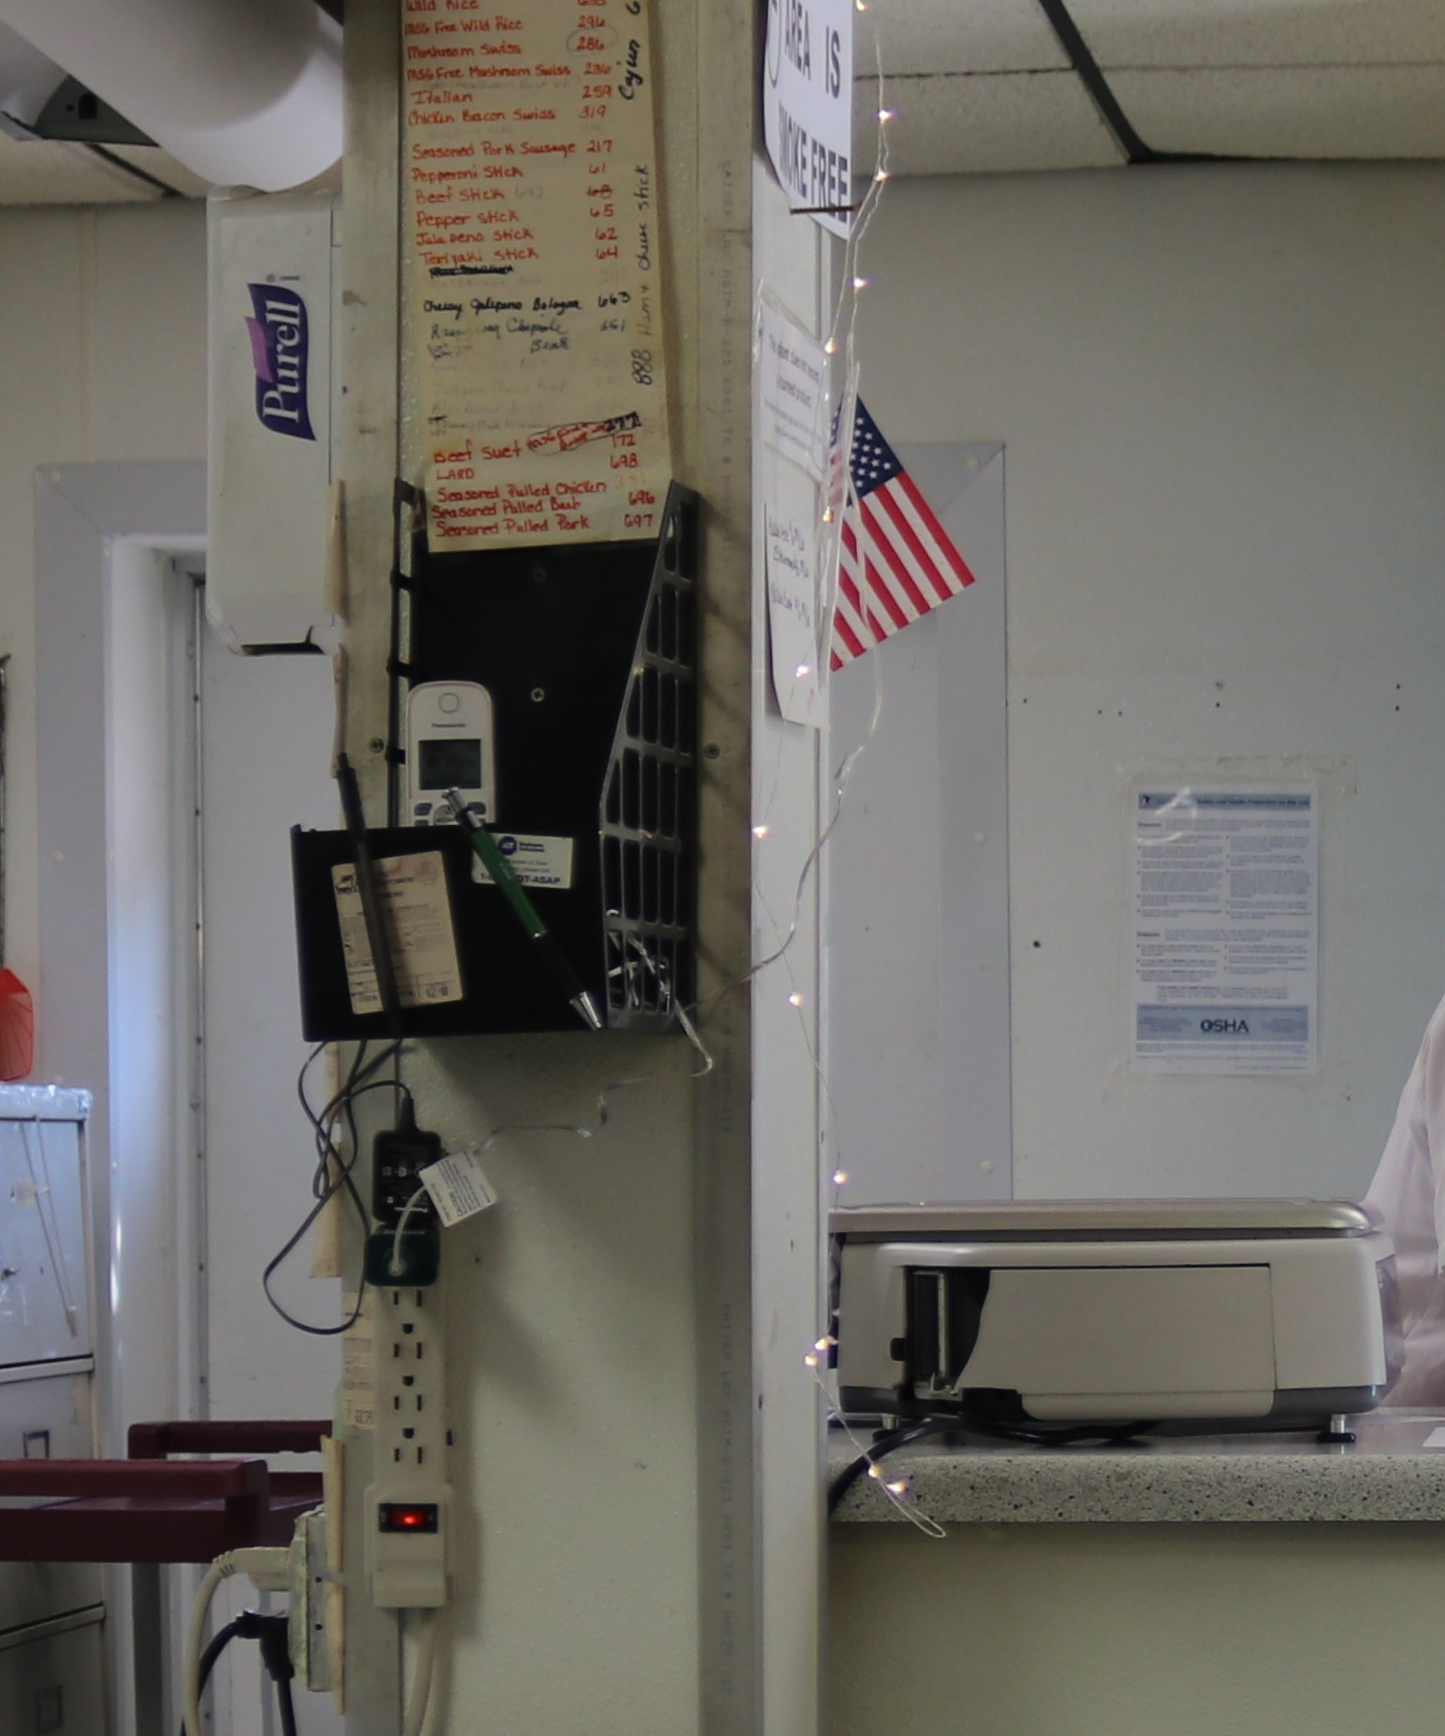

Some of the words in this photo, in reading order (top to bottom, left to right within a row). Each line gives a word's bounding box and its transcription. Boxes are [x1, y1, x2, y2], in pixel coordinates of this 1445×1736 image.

[461, 16, 491, 31] Wild
[495, 15, 523, 30] Rice
[480, 43, 522, 55] Swiss
[535, 63, 572, 76] Swiss
[617, 39, 643, 100] Cajun
[826, 26, 841, 99] IS
[411, 88, 473, 105] Italian
[582, 85, 612, 99] 259
[408, 109, 454, 127] Chicken
[462, 109, 505, 122] Bacon
[513, 107, 556, 120] Swiss
[578, 105, 606, 118] 319
[412, 142, 475, 160] Seasoned
[481, 141, 515, 157] Pork
[587, 140, 613, 152] 217
[411, 164, 478, 184] Pepperoni
[483, 165, 524, 179] Stick
[811, 138, 848, 223] FREE
[417, 210, 471, 227] Pepper
[590, 204, 614, 218] 65
[595, 227, 619, 241] 62
[596, 246, 619, 260] 64
[262, 299, 301, 424] Purell
[434, 441, 473, 463] Beef
[436, 468, 475, 480] LARD
[437, 487, 500, 503] Seasoned
[507, 481, 550, 498] Pulled
[556, 481, 606, 495] Chicken
[431, 504, 497, 519] Seasoned
[503, 499, 544, 515] Pulled
[435, 521, 499, 538] Seasoned
[504, 517, 549, 533] Pulled
[556, 513, 590, 531] Pork
[1200, 1018, 1250, 1034] OSHA
